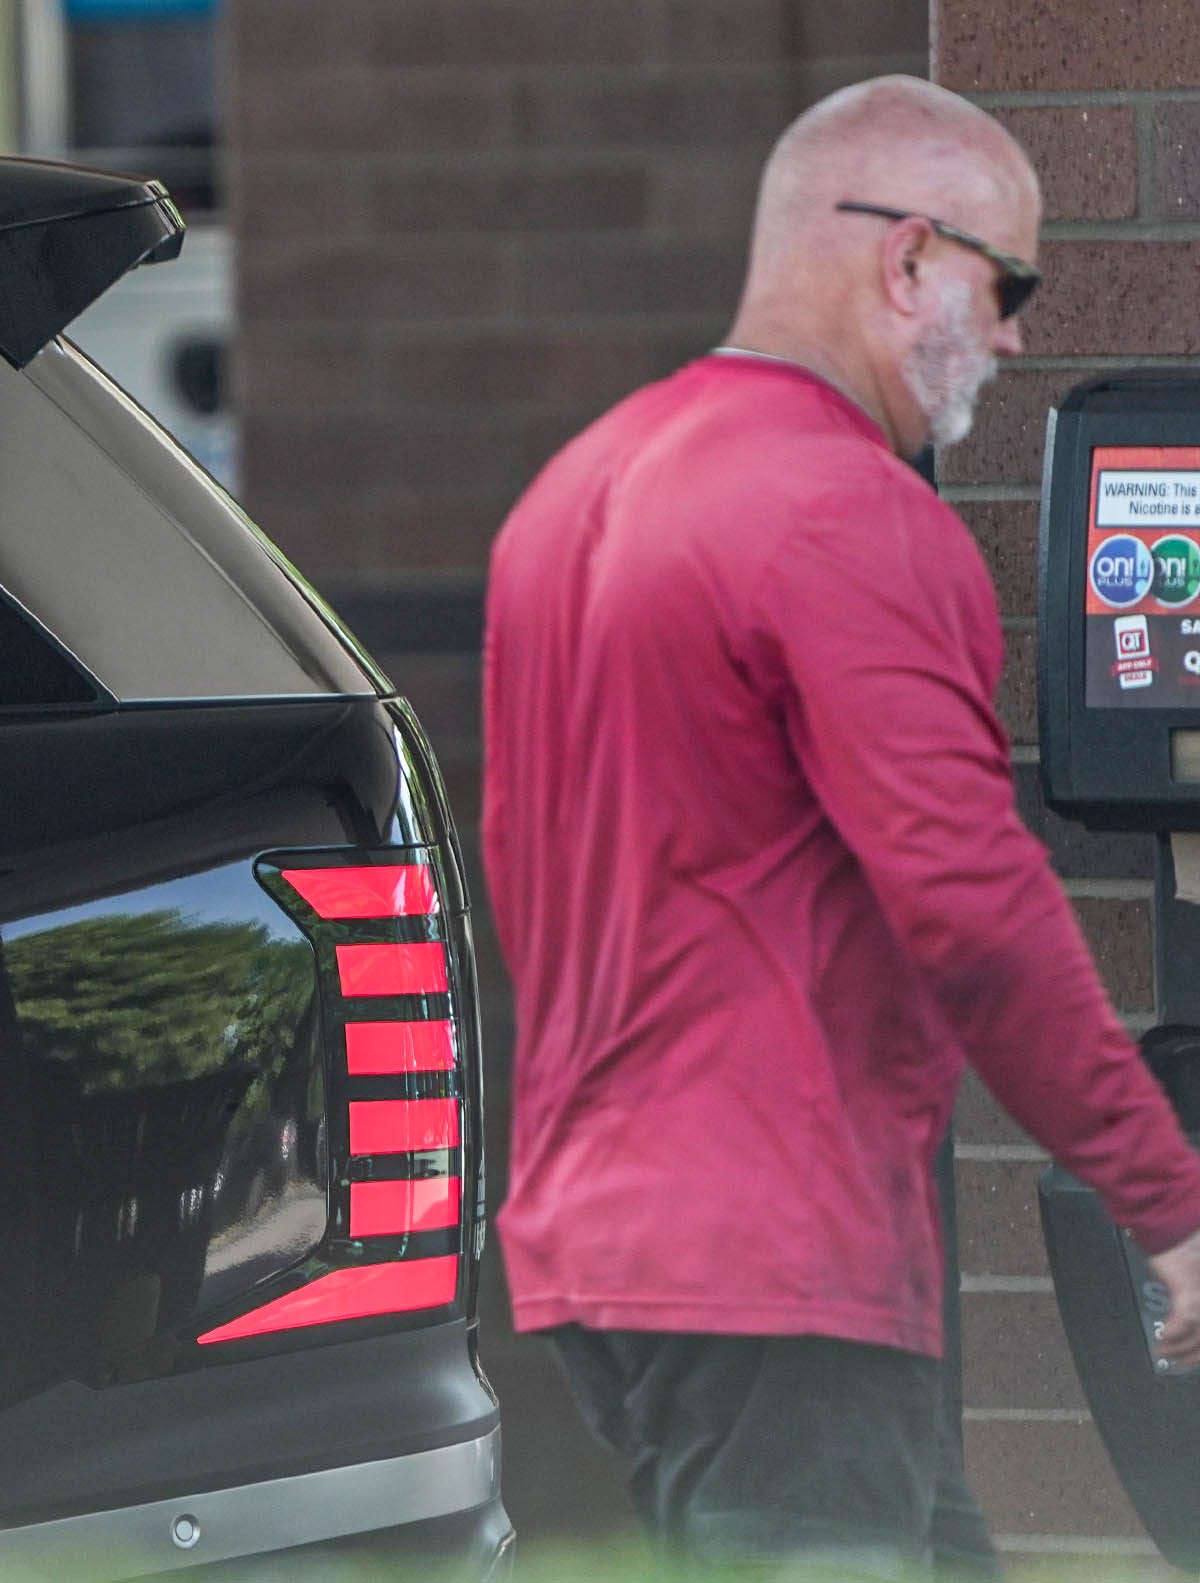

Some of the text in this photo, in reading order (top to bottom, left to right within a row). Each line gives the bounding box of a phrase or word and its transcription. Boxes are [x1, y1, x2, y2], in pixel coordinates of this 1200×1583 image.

[1104, 482, 1197, 497] WARNING: This
[1181, 501, 1191, 515] is
